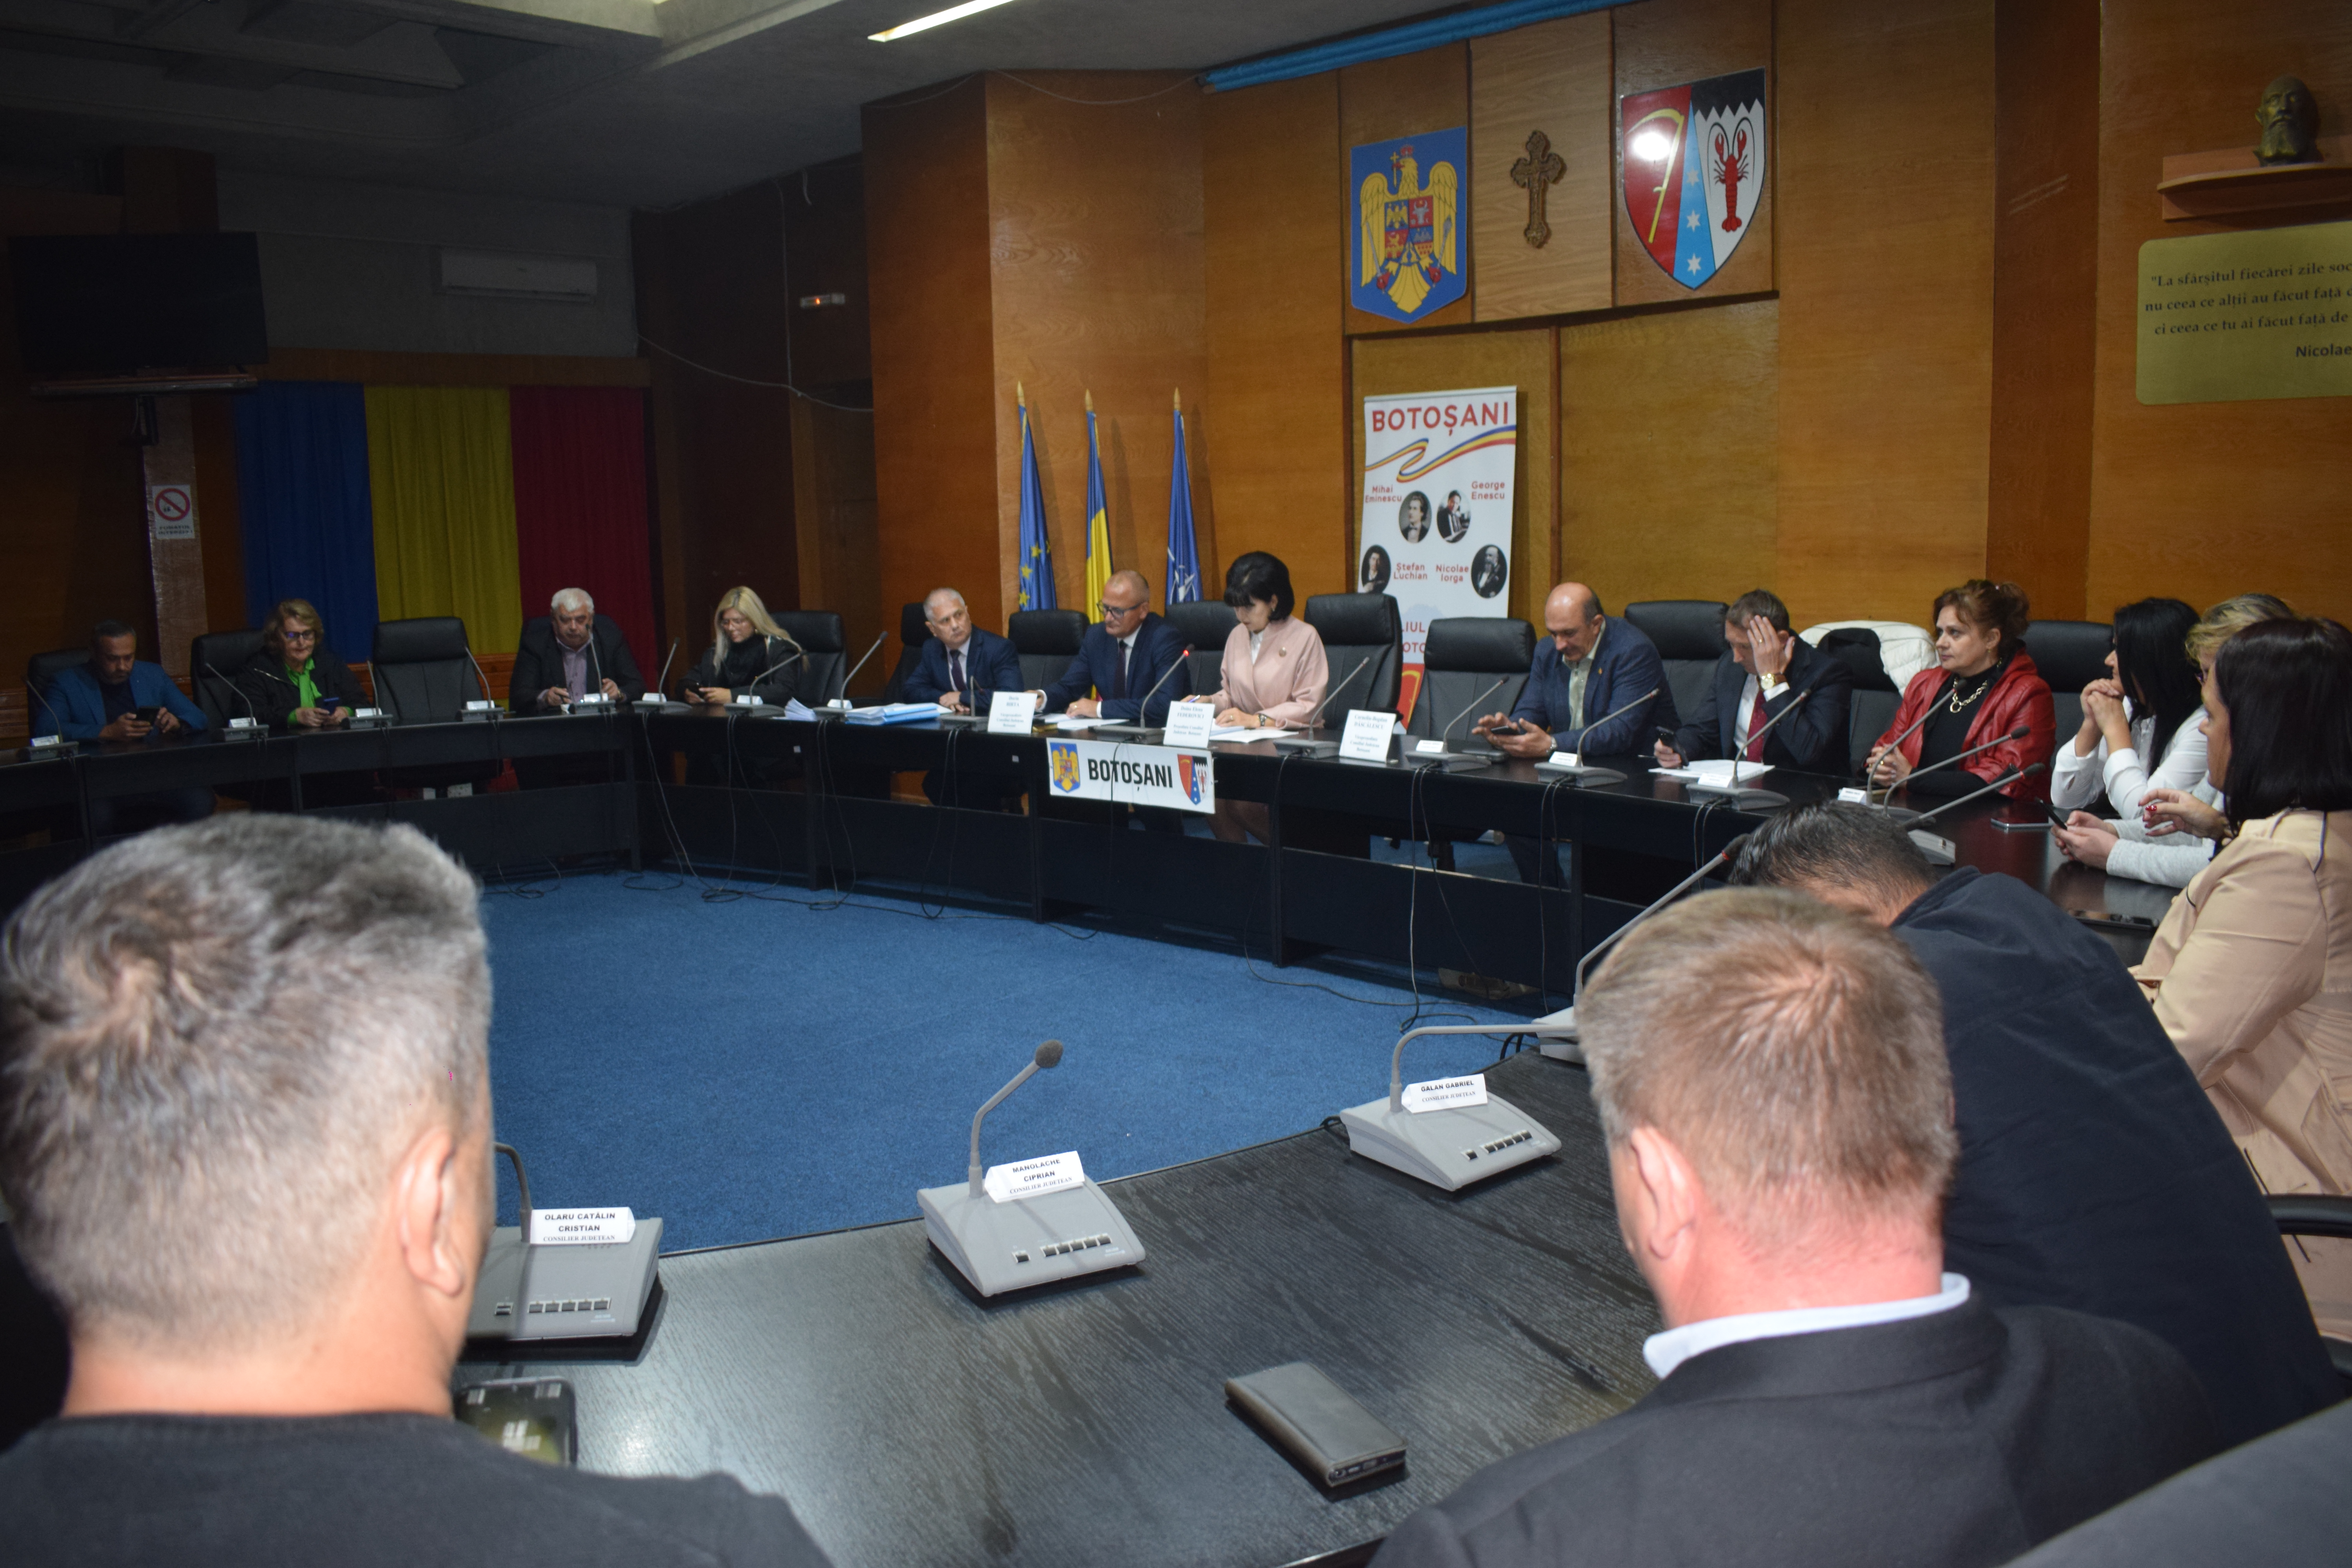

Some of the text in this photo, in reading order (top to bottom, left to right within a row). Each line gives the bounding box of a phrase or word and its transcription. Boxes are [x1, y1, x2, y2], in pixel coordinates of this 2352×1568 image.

[2151, 275, 2173, 286] "La
[2240, 264, 2293, 280] fiecărei
[2298, 263, 2324, 275] zile
[2145, 303, 2162, 311] nu
[2167, 299, 2196, 310] ceea
[2200, 298, 2215, 308] ce
[2252, 295, 2269, 303] au
[2273, 289, 2309, 302] făcut
[2154, 323, 2166, 335] ci
[2170, 324, 2199, 334] ceea
[2203, 322, 2218, 332] ce
[2222, 320, 2236, 330] tu
[2241, 317, 2254, 329] ai
[2258, 315, 2294, 328] făcut
[2330, 311, 2348, 323] de
[2296, 343, 2352, 358] Nicolae
[1372, 401, 1508, 436] BOTOȘANI
[1372, 485, 1393, 494] Mihai
[1471, 481, 1505, 491] George
[1365, 494, 1402, 503] Eminescu
[1471, 492, 1505, 500] Enescu
[1396, 563, 1425, 573] Ștefan
[1436, 564, 1469, 573] Nicolae
[1393, 572, 1428, 580] Luchian
[1441, 573, 1463, 583] Iorga
[1087, 758, 1173, 792] BOTOȘANI
[1445, 1080, 1474, 1089] GABRIEL
[1012, 1158, 1061, 1173] MANOLACHE
[1024, 1170, 1055, 1182] CIPRIAN
[1010, 1183, 1042, 1194] CONSILIER
[577, 1211, 615, 1220] CATĂLIN
